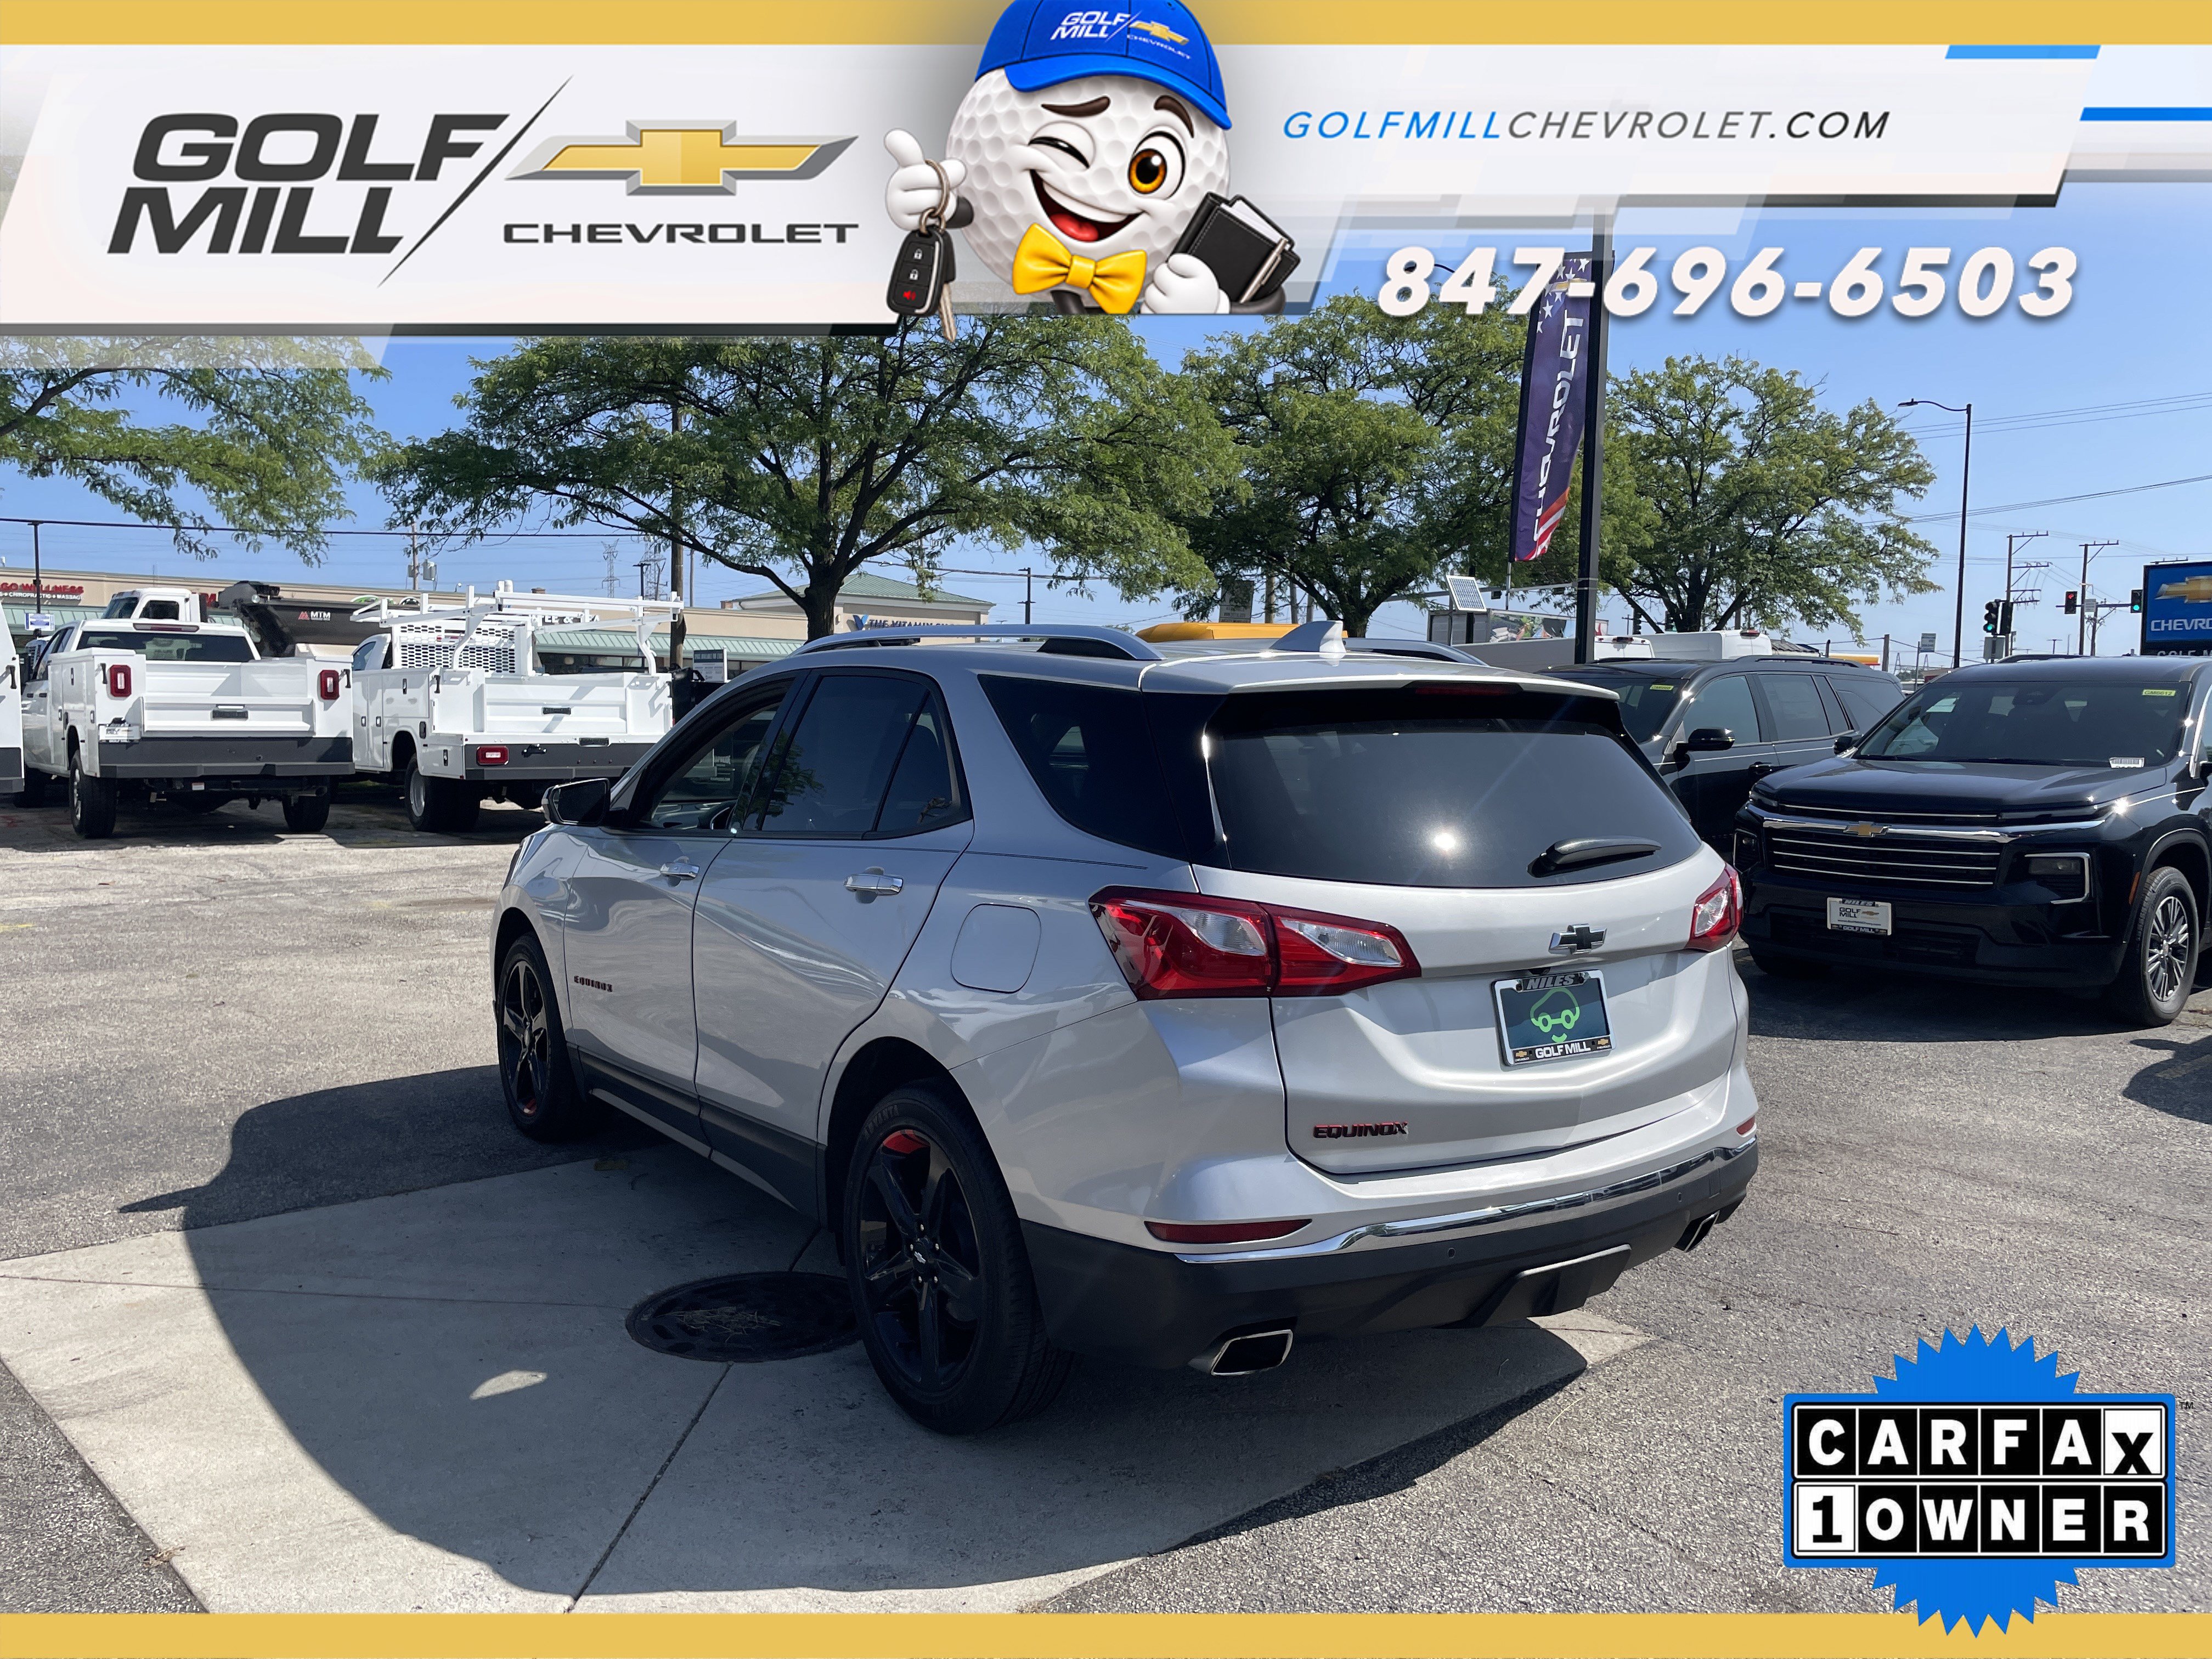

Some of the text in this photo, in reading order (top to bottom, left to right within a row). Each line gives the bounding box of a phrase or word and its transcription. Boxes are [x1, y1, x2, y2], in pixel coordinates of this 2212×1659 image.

[869, 619, 888, 628] THE
[574, 975, 612, 992] EQUINOX
[1526, 974, 1575, 990] NILES
[1535, 1041, 1591, 1059] GOLF MILL
[1313, 1121, 1408, 1139] EQUINOX
